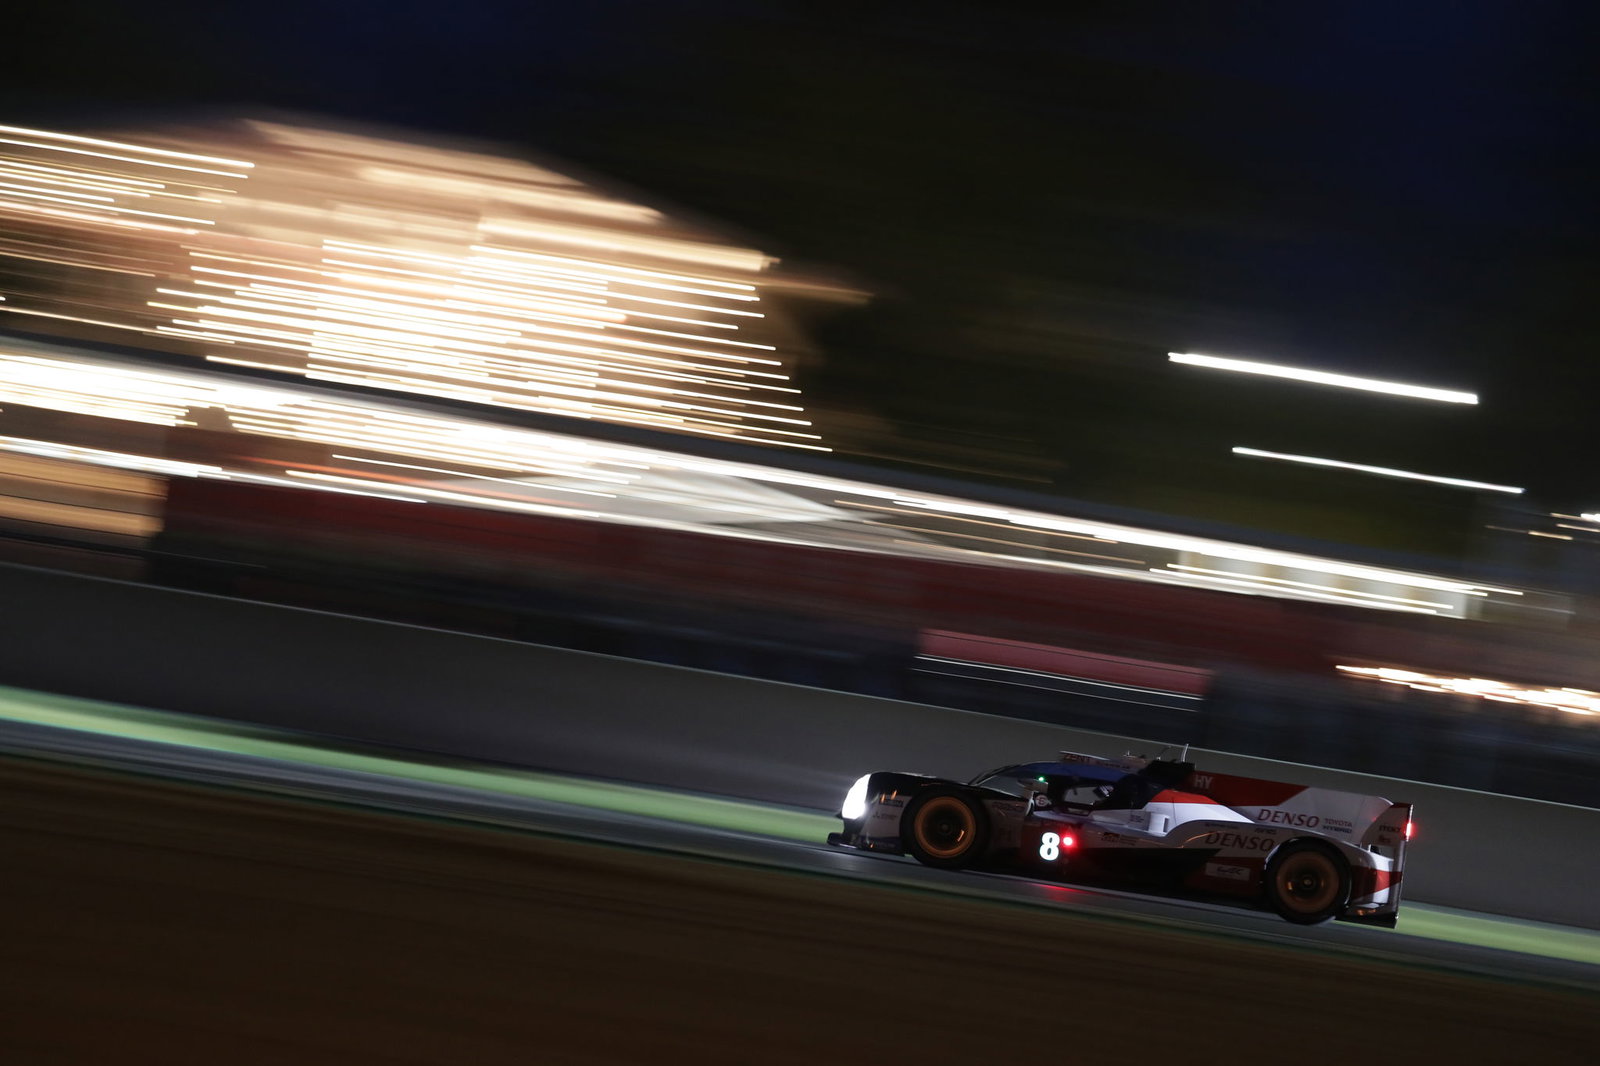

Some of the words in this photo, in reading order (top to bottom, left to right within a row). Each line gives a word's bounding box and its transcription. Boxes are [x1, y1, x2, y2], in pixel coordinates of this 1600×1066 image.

[1193, 774, 1213, 790] HY
[1257, 808, 1320, 828] DENSO
[1324, 818, 1353, 828] TOYOTA
[1039, 832, 1060, 861] 8
[1205, 831, 1275, 852] DENSO
